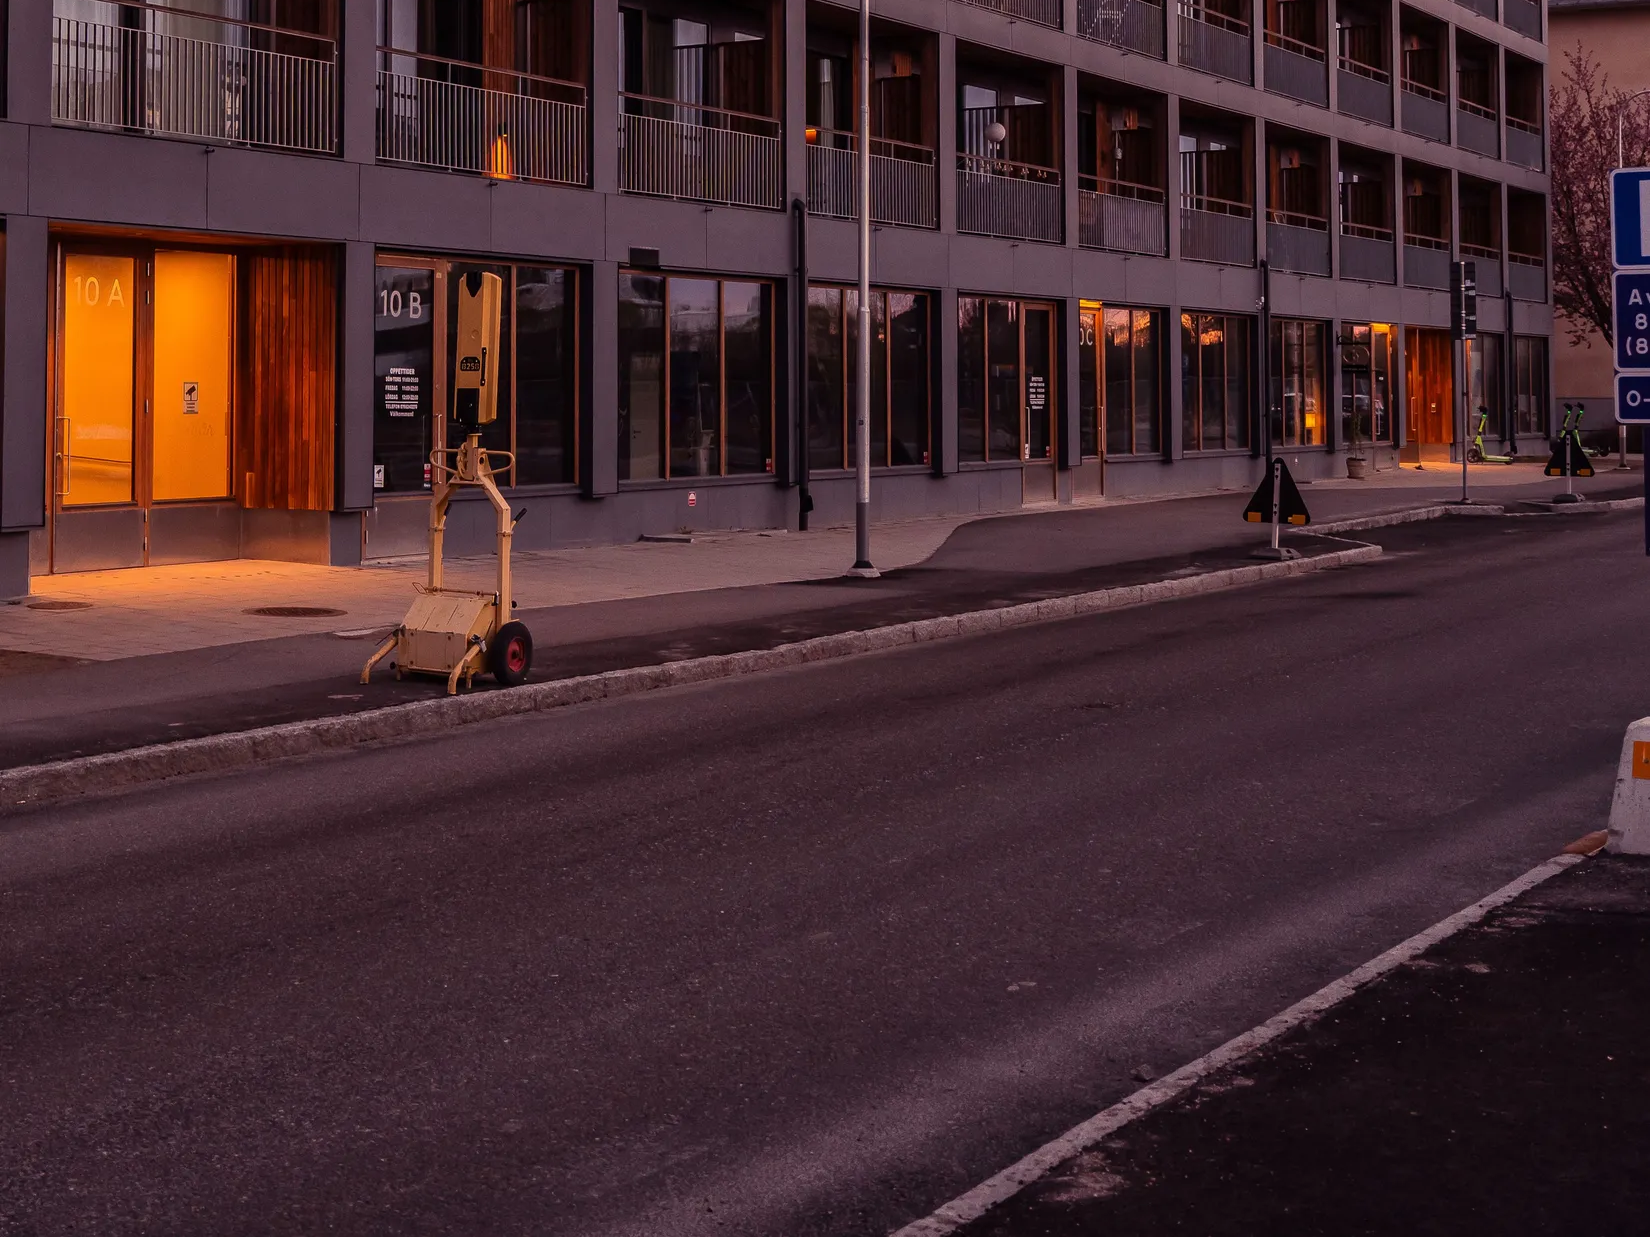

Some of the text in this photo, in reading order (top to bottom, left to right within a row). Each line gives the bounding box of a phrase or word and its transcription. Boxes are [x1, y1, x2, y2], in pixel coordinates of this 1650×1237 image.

[74, 276, 125, 308] 10 A
[381, 289, 422, 319] 10 B
